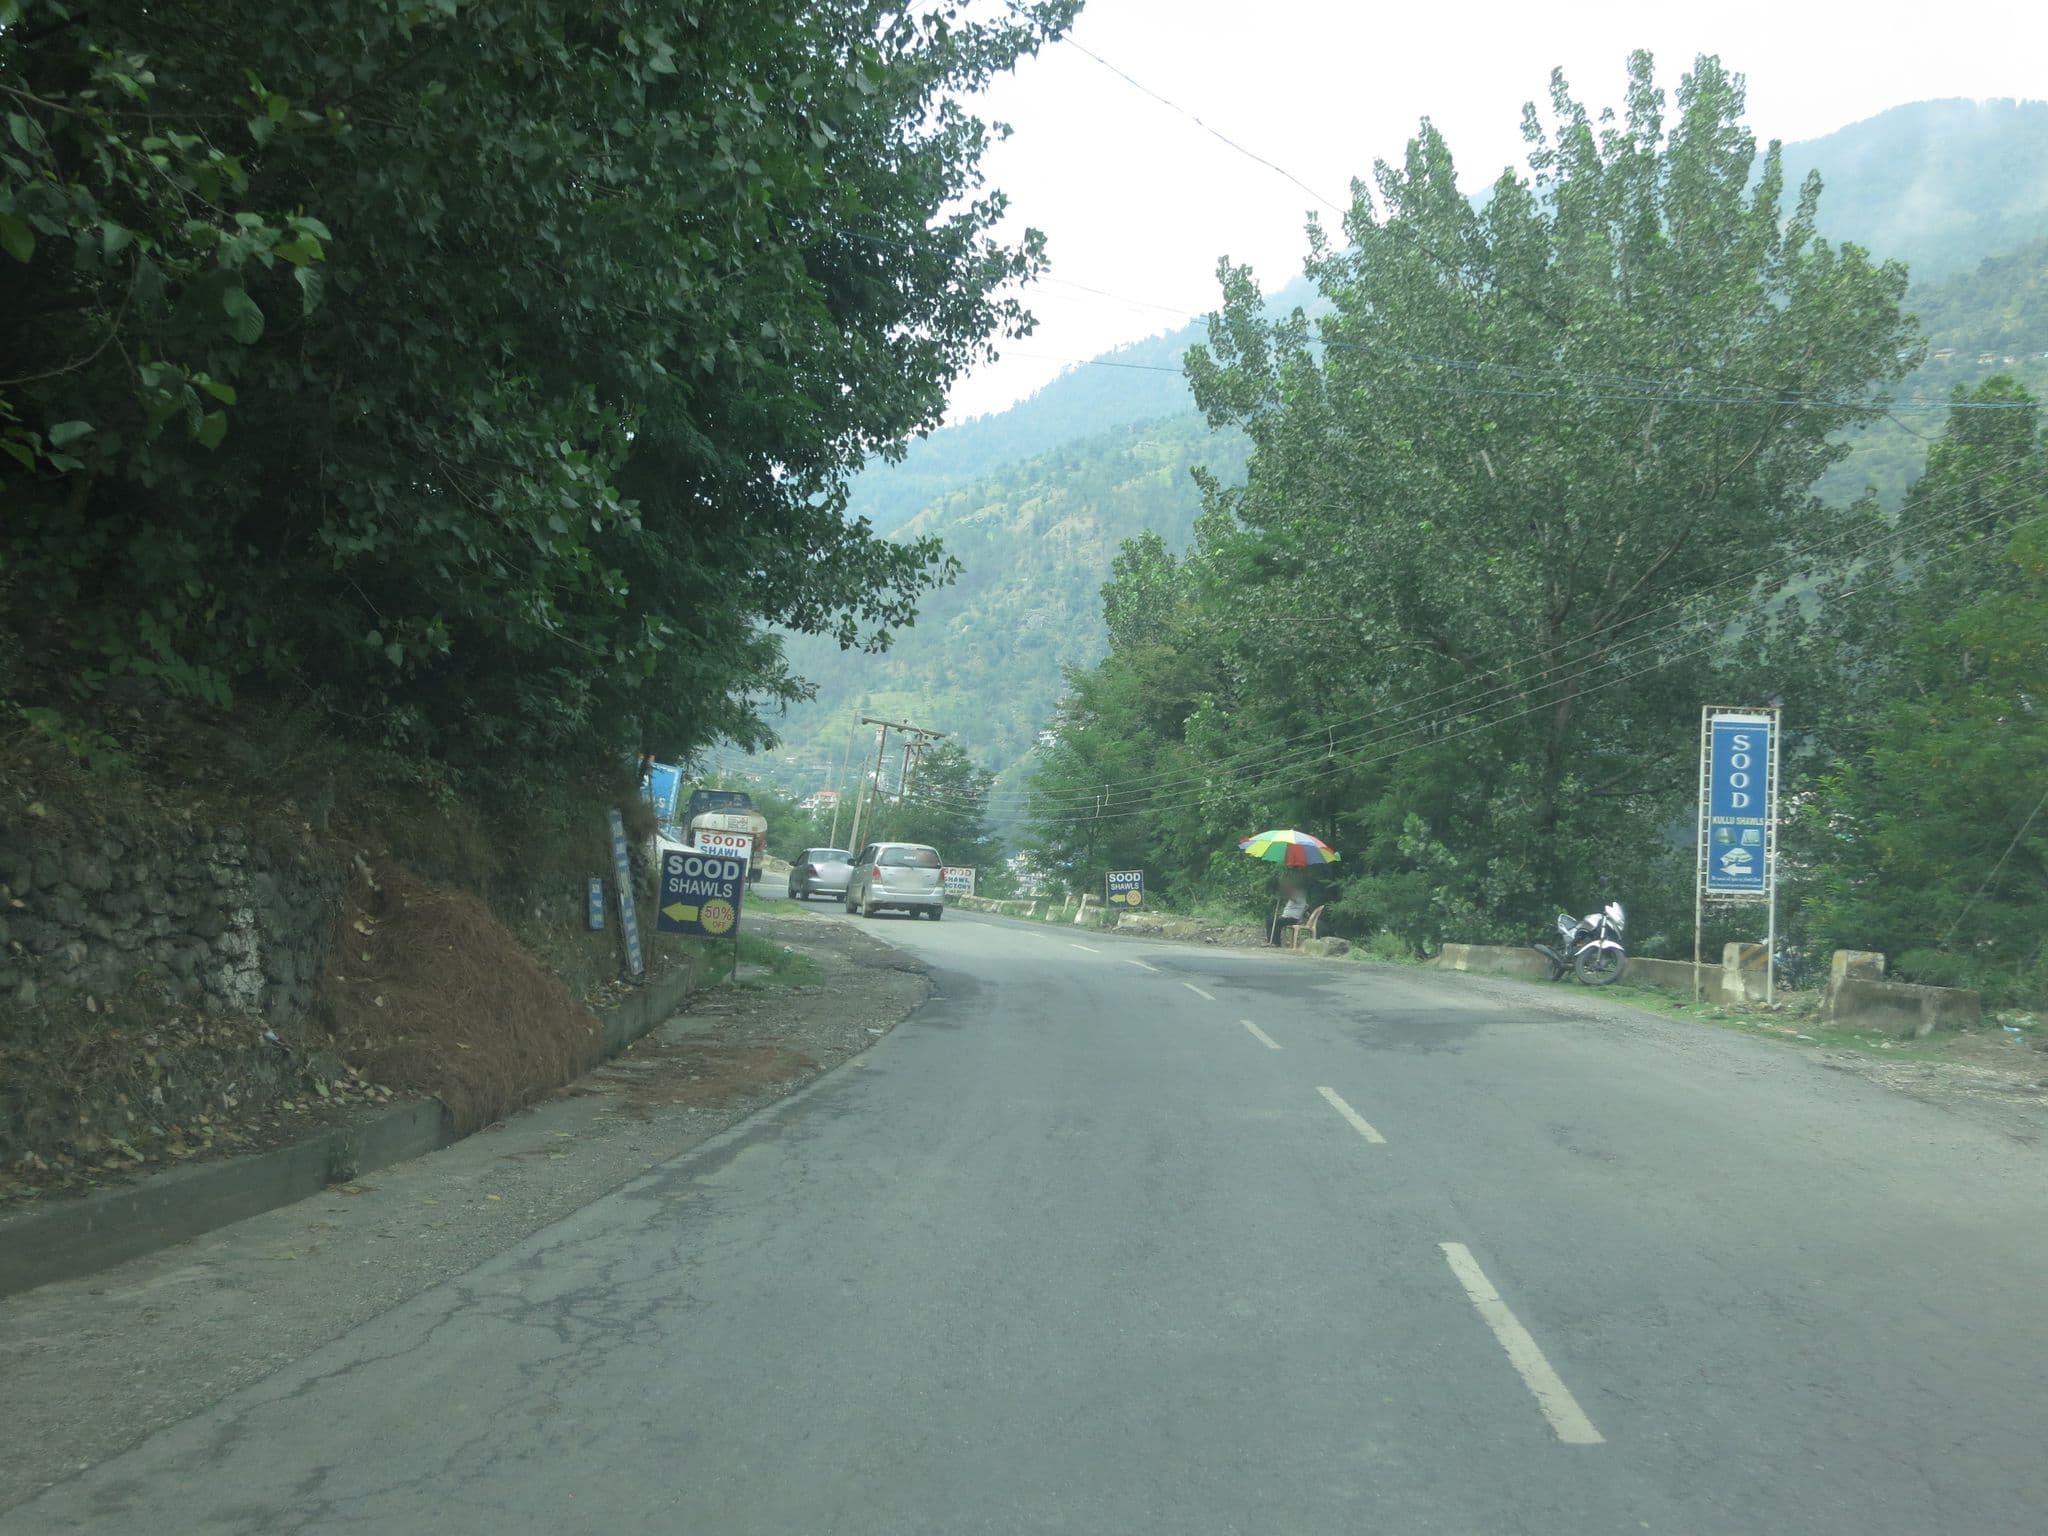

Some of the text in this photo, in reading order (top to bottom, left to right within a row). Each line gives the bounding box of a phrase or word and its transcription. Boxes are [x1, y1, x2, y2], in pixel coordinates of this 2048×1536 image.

[1730, 734, 1752, 808] SOOD
[1712, 815, 1736, 825] KULLU
[701, 834, 746, 848] SOOD
[667, 855, 740, 881] SOOD
[1109, 872, 1141, 883] SOOD
[668, 877, 733, 898] SHAWLS
[1110, 882, 1140, 891] SHAWLS
[704, 905, 733, 921] 50%
[712, 920, 727, 930] OFF
